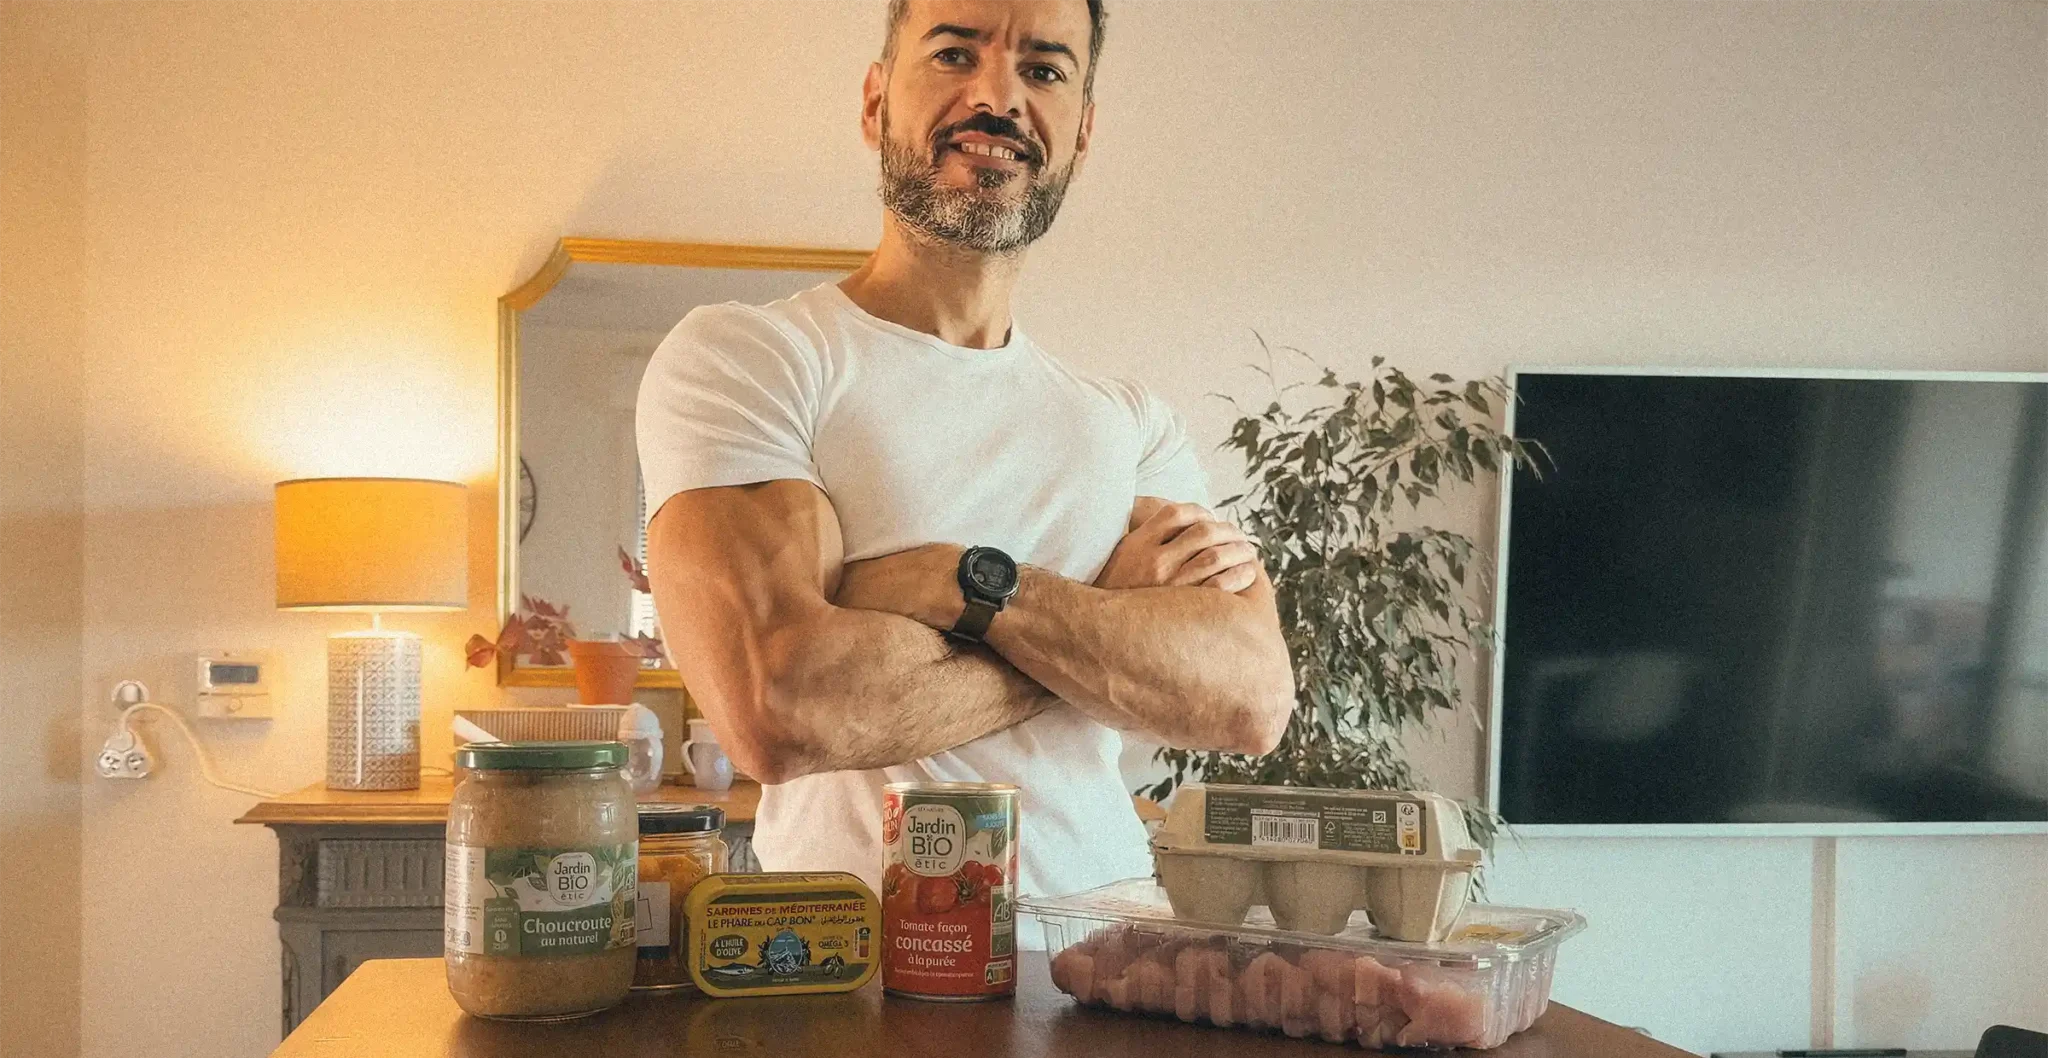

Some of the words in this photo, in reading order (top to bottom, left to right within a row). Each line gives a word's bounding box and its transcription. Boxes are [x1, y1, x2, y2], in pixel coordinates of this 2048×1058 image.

[908, 815, 956, 835] Jardin
[554, 861, 591, 875] Jardin
[706, 906, 763, 917] SARDINES
[765, 907, 777, 915] DE
[779, 901, 867, 915] MÉDITERRANÉE
[523, 917, 612, 934] Choucroute
[708, 919, 719, 929] LE
[720, 918, 753, 928] PHARE
[766, 917, 788, 927] CAP
[899, 919, 935, 932] Tomate
[938, 922, 968, 935] façon
[541, 937, 556, 947] au
[559, 931, 599, 946] naturel
[721, 938, 744, 948] L'HUILE
[895, 934, 973, 953] concassé
[716, 948, 742, 957] D'OLIVE
[908, 954, 915, 965] à
[915, 955, 925, 966] la
[925, 956, 956, 968] purée
